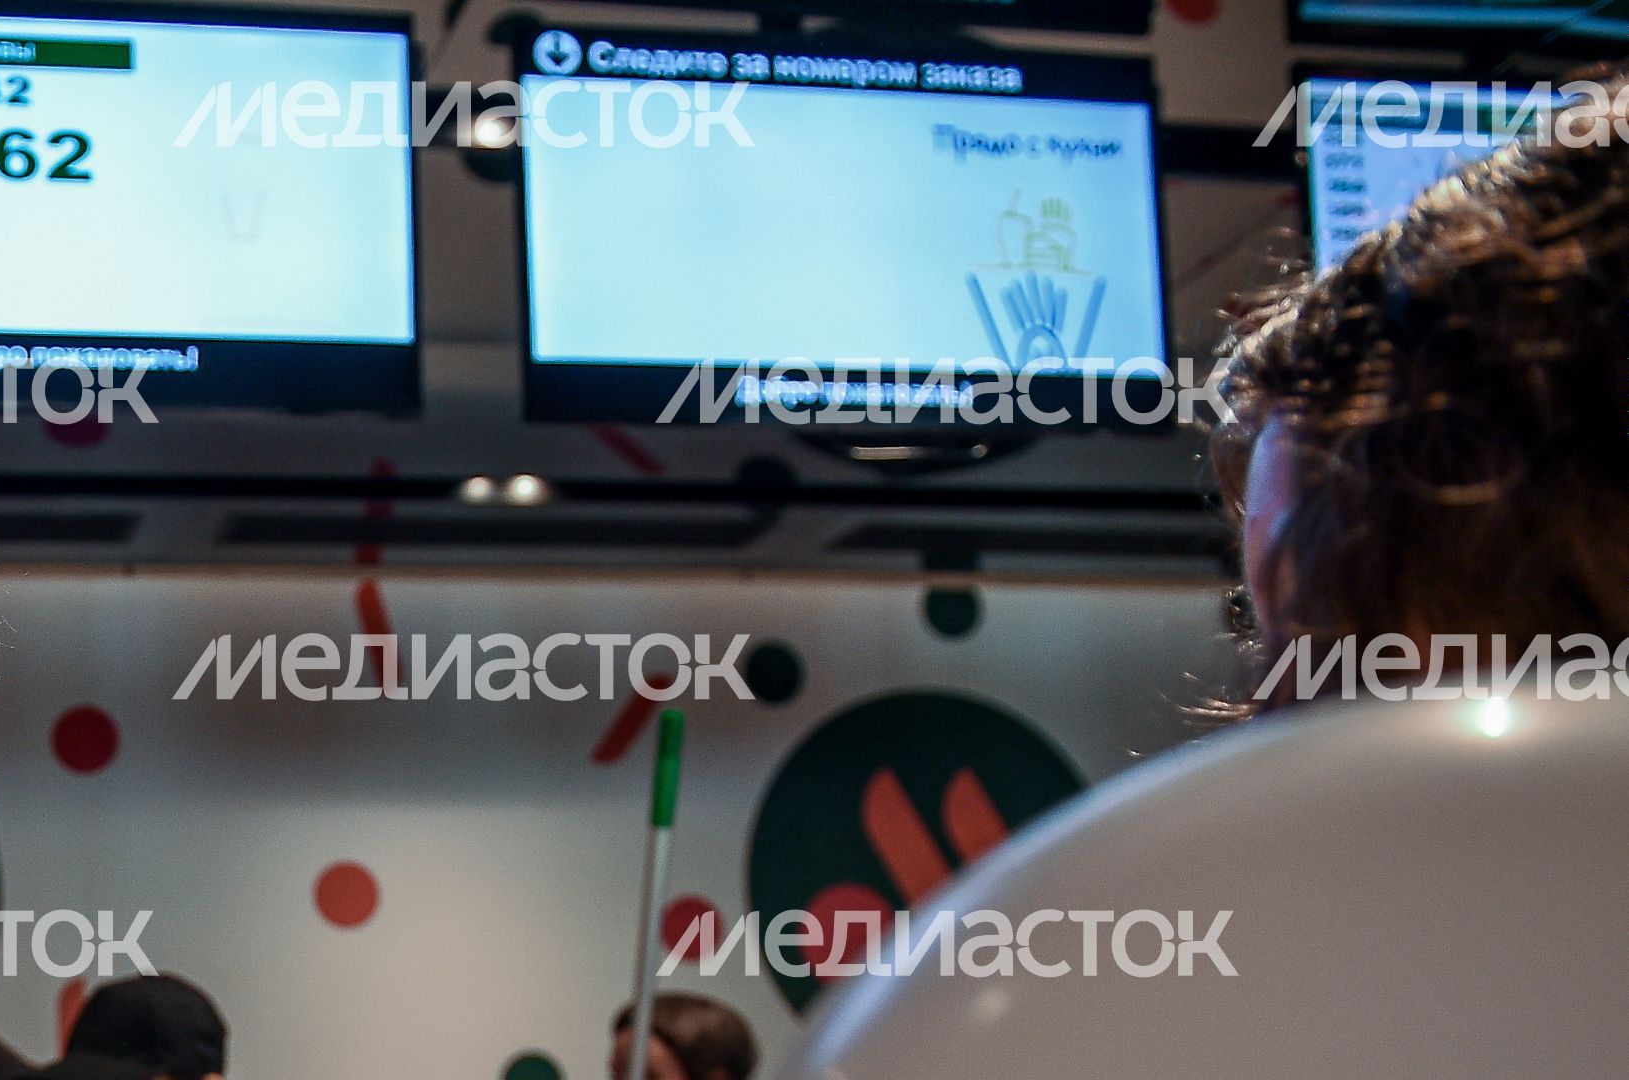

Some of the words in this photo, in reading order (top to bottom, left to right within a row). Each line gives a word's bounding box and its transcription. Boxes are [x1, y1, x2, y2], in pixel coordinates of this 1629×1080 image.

[587, 40, 729, 80] Следите
[730, 52, 770, 82] за
[772, 55, 918, 90] номером
[919, 62, 1023, 95] заказа
